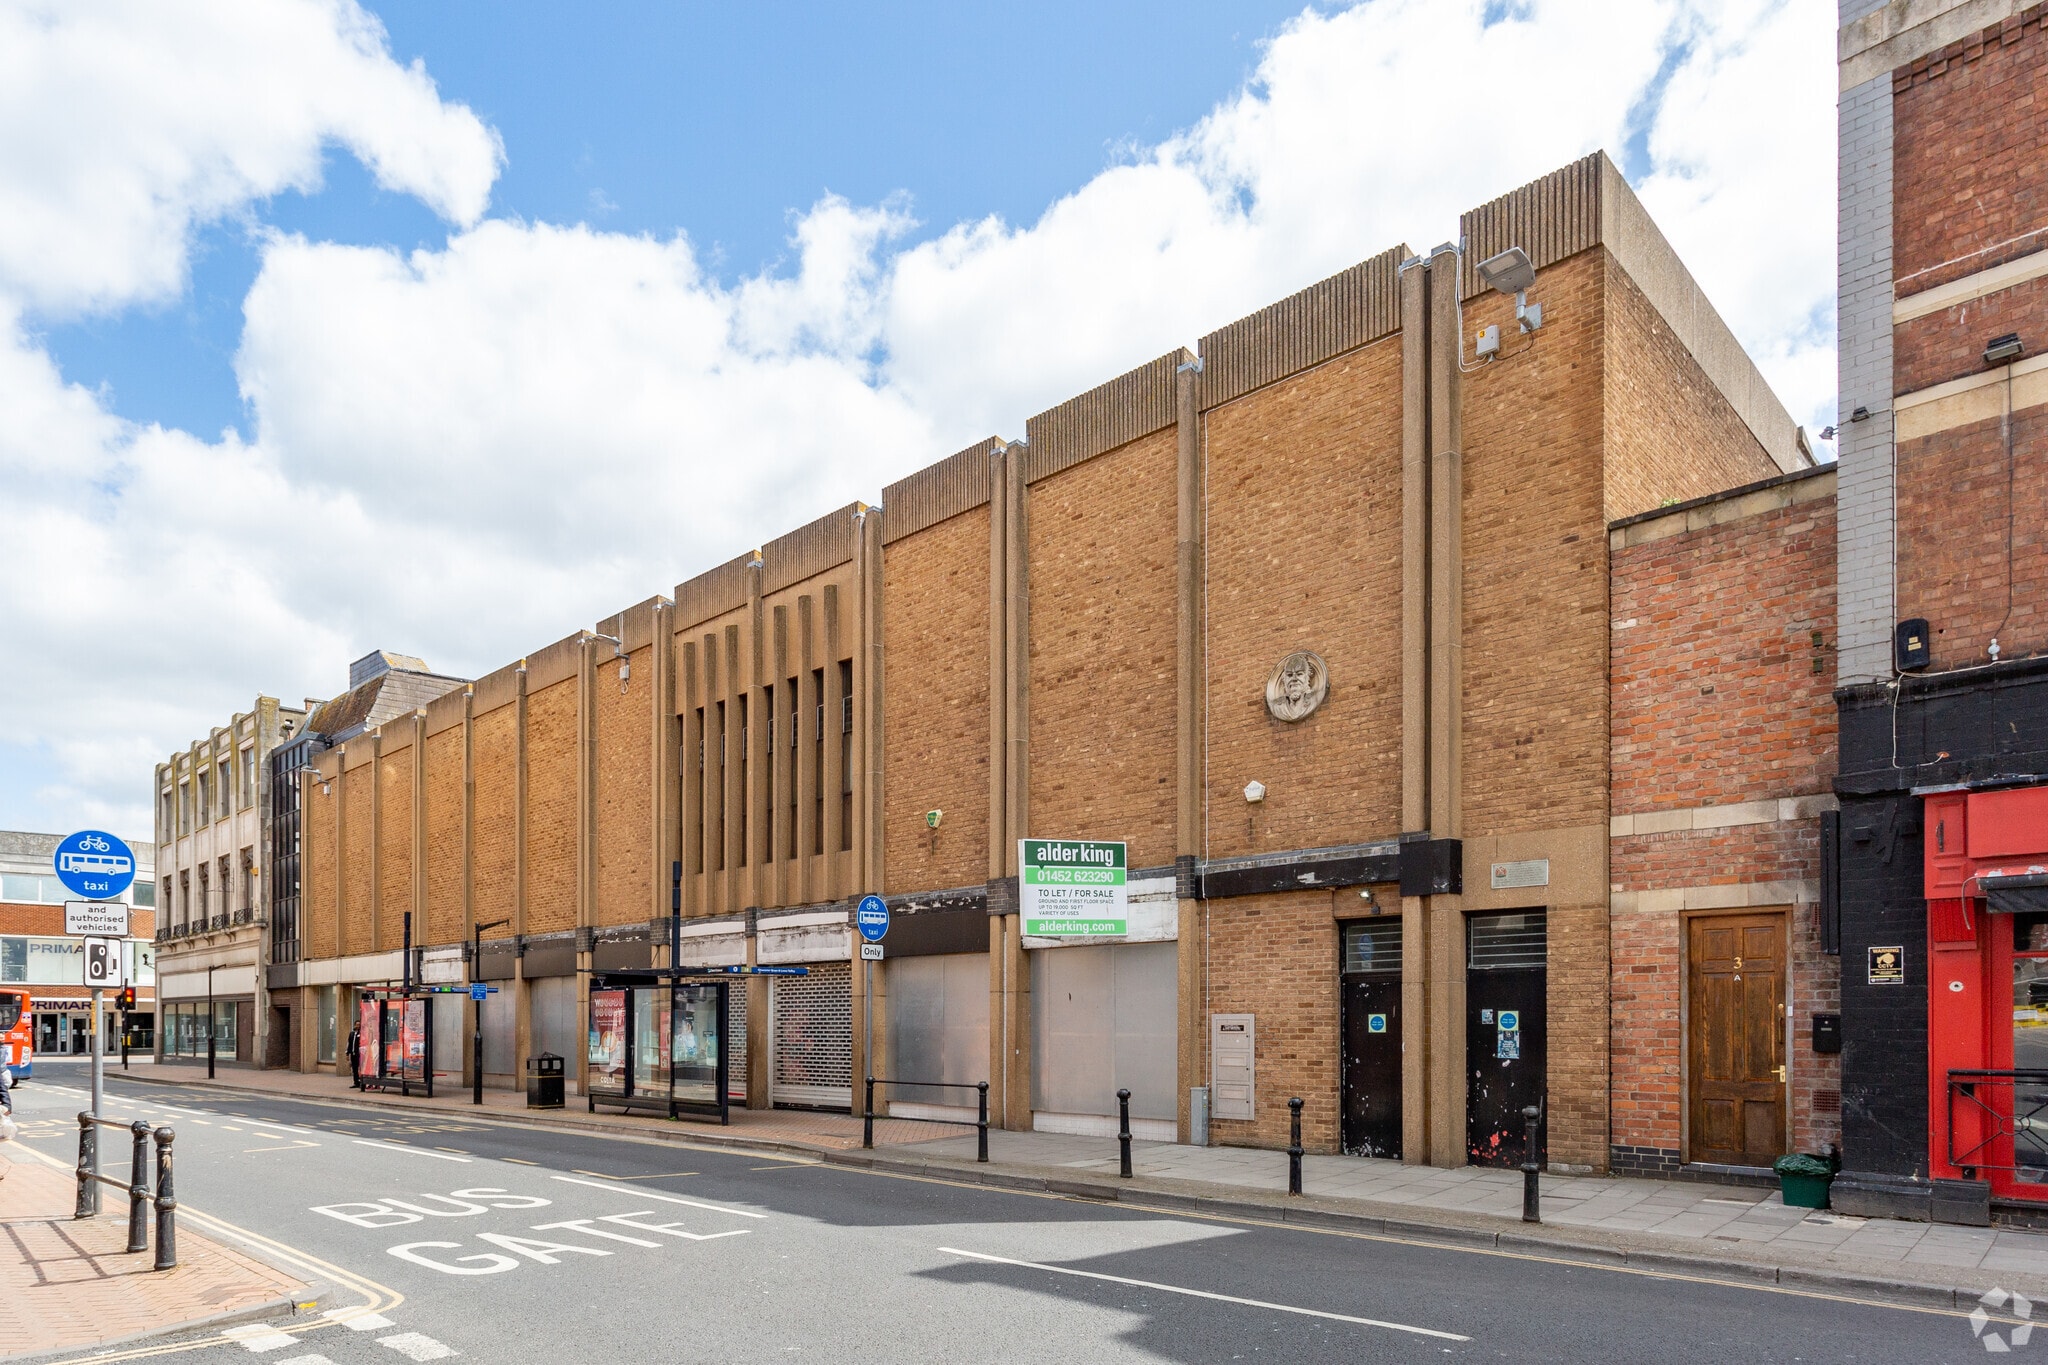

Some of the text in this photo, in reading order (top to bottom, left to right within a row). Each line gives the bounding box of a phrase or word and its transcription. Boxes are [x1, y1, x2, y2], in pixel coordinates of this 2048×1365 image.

[1037, 843, 1113, 866] alder king
[1038, 870, 1114, 882] 01452 623290
[83, 880, 108, 890] taxi
[1039, 889, 1049, 897] TO
[77, 923, 117, 931] vehicles
[1039, 921, 1115, 933] alderking.com
[30, 944, 84, 954] PRIMA
[864, 948, 881, 957] Only
[1734, 957, 1742, 969] 3
[30, 1001, 104, 1010] PRIMAR
[308, 1188, 552, 1228] BUS
[386, 1211, 752, 1275] GATE
